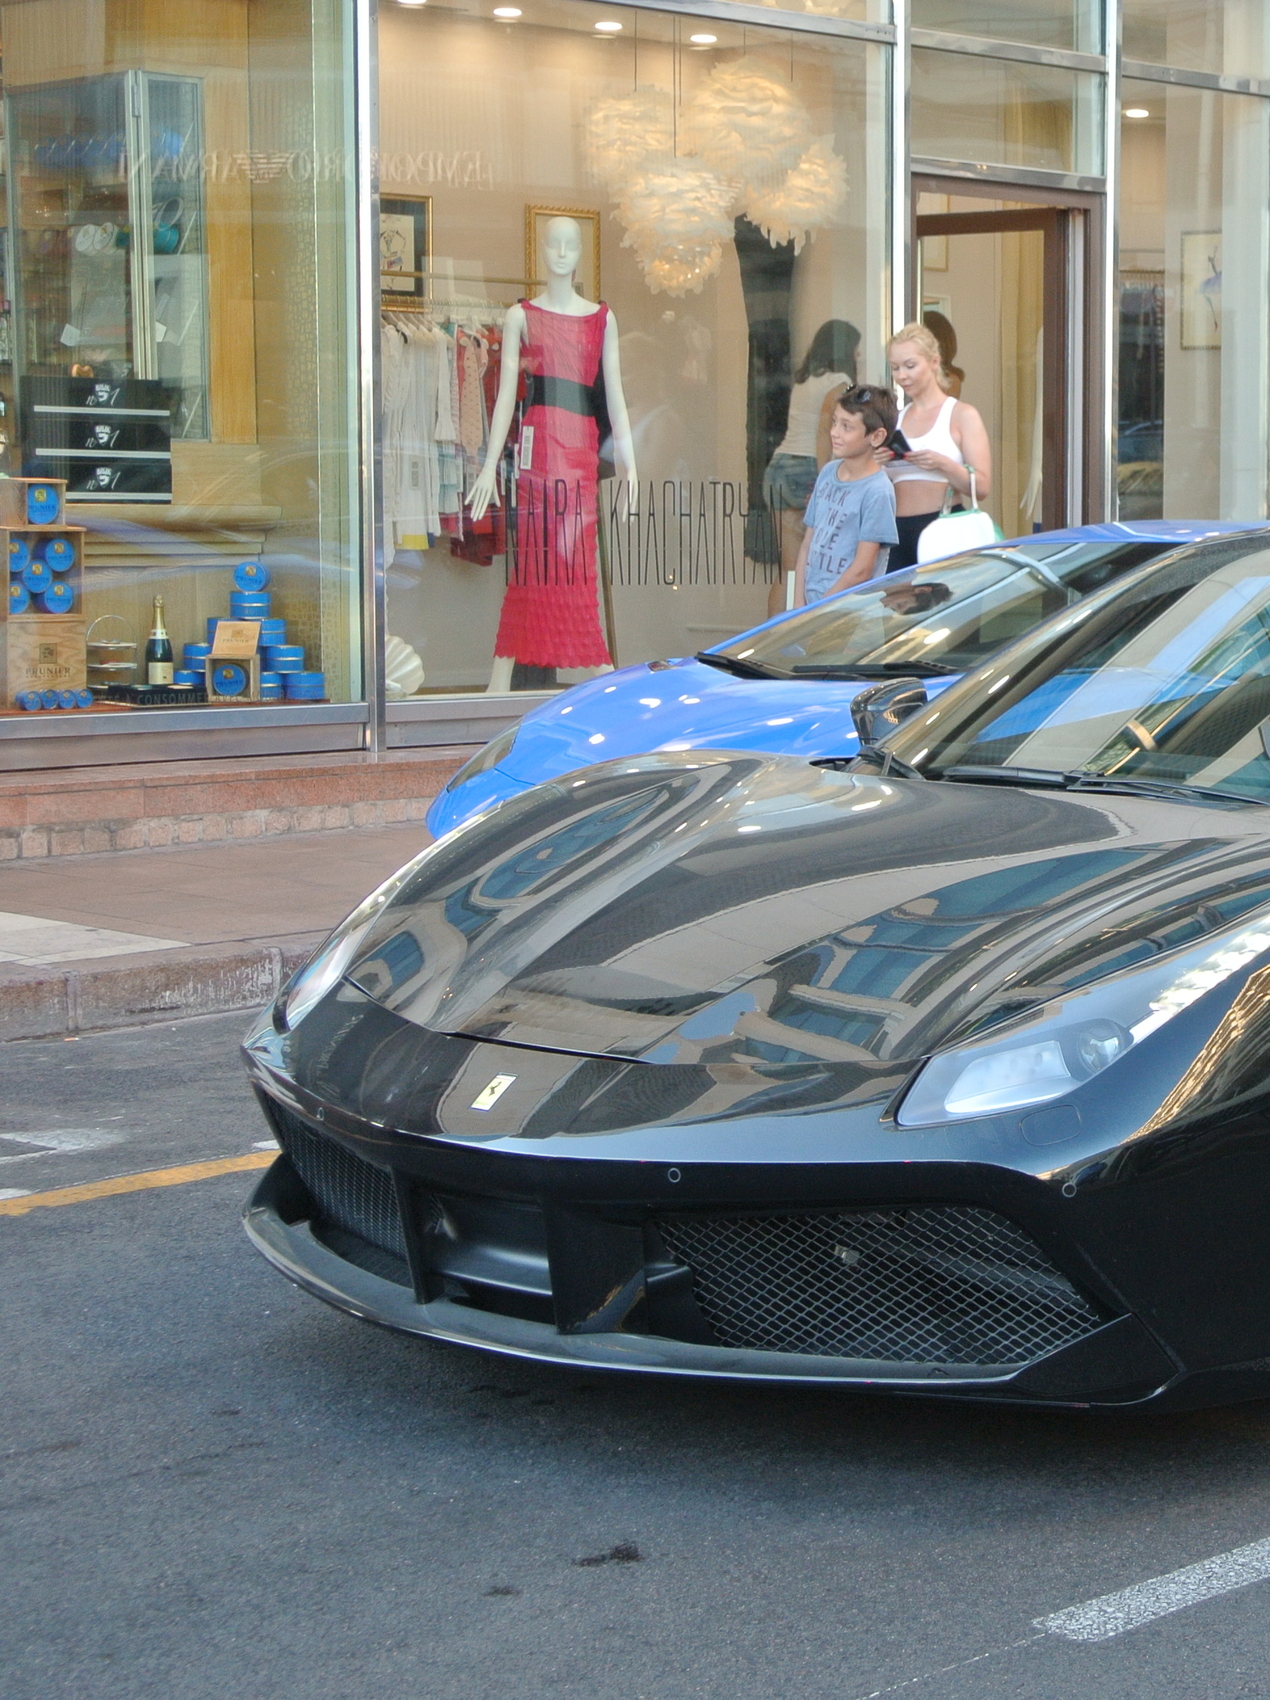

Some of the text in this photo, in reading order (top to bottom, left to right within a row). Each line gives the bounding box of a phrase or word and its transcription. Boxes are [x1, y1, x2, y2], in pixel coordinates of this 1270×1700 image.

[504, 478, 784, 587] NAIRA KHACHATRYAN
[25, 667, 71, 675] PRUNIER
